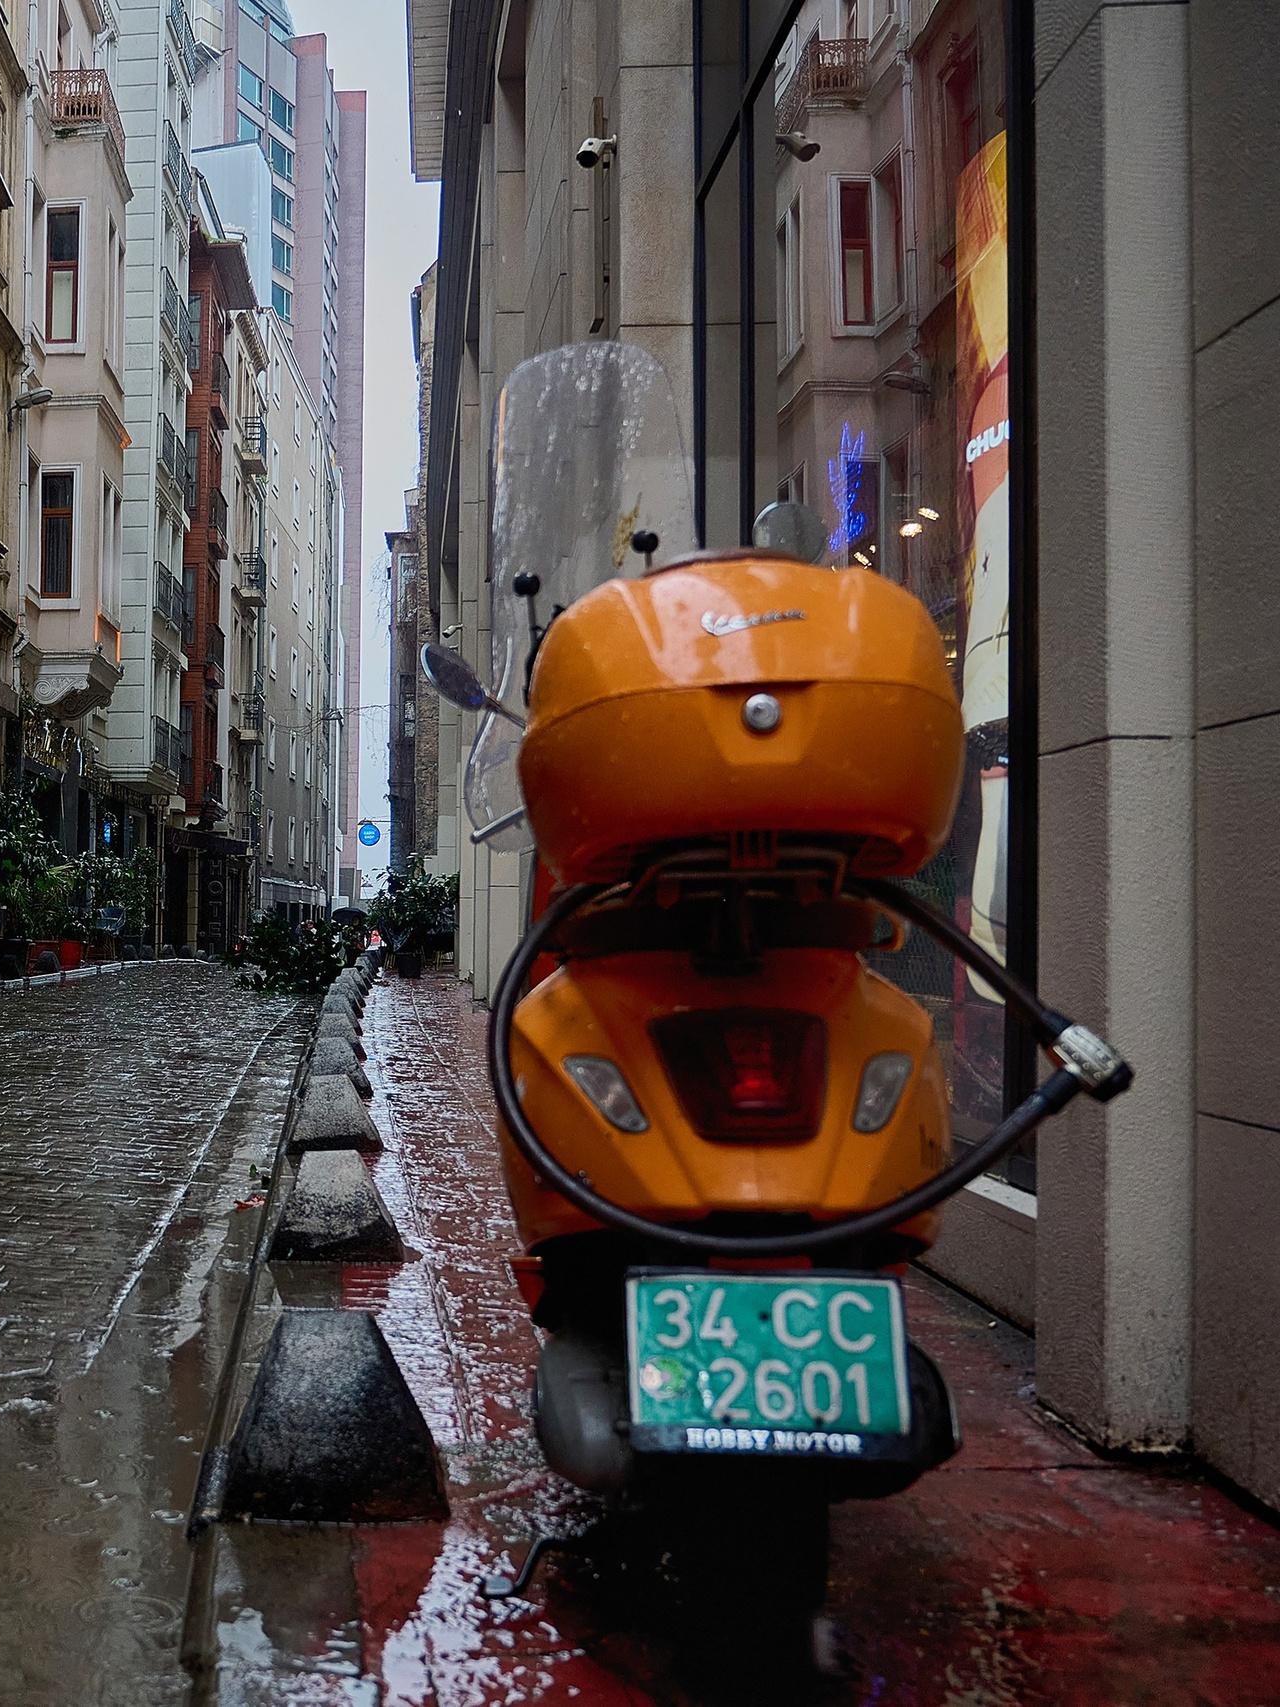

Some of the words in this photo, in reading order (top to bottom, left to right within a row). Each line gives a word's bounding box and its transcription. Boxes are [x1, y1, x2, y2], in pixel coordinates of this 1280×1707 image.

[653, 1287, 739, 1350] 34
[771, 1287, 877, 1354] CC
[708, 1356, 871, 1427] 2601
[771, 1429, 864, 1455] MOTOR
